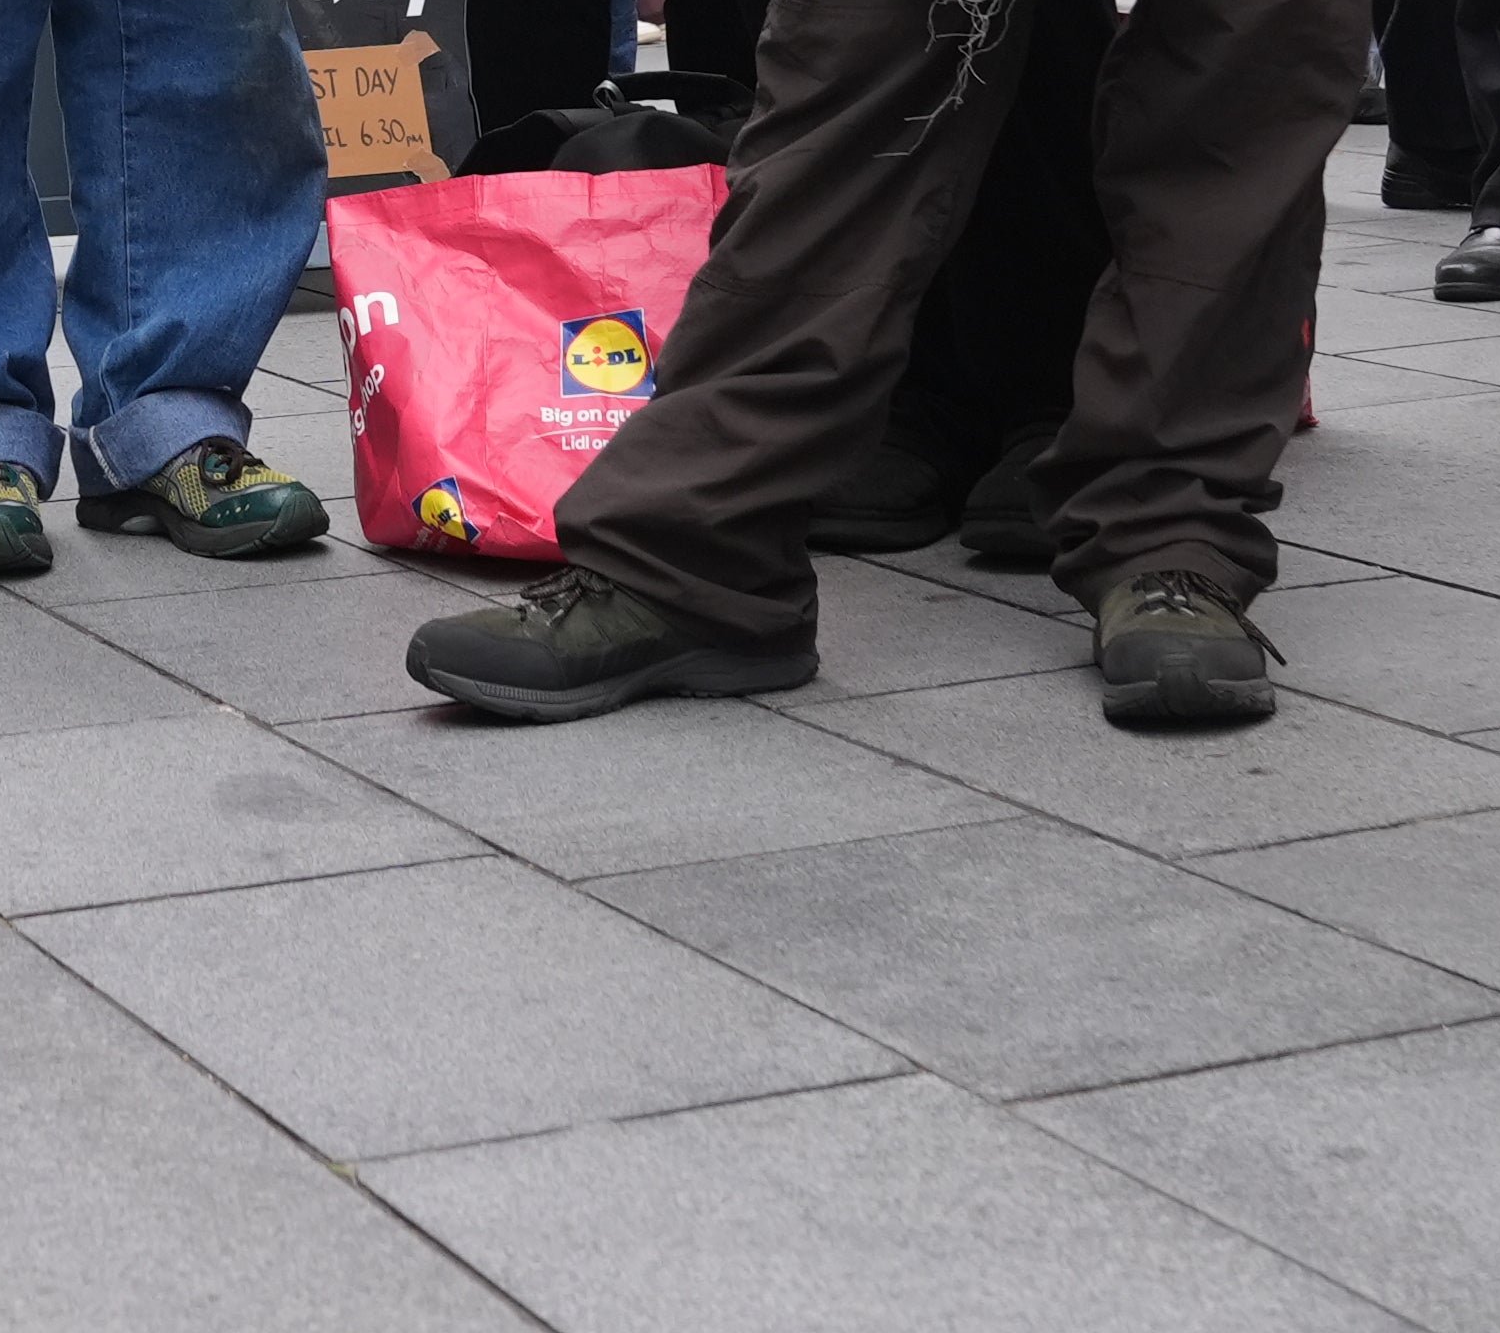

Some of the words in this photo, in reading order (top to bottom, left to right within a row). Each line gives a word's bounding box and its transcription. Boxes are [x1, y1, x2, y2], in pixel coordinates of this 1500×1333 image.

[354, 66, 399, 98] DAY
[540, 407, 573, 427] Big
[576, 408, 603, 423] on
[561, 437, 590, 451] Lidl
